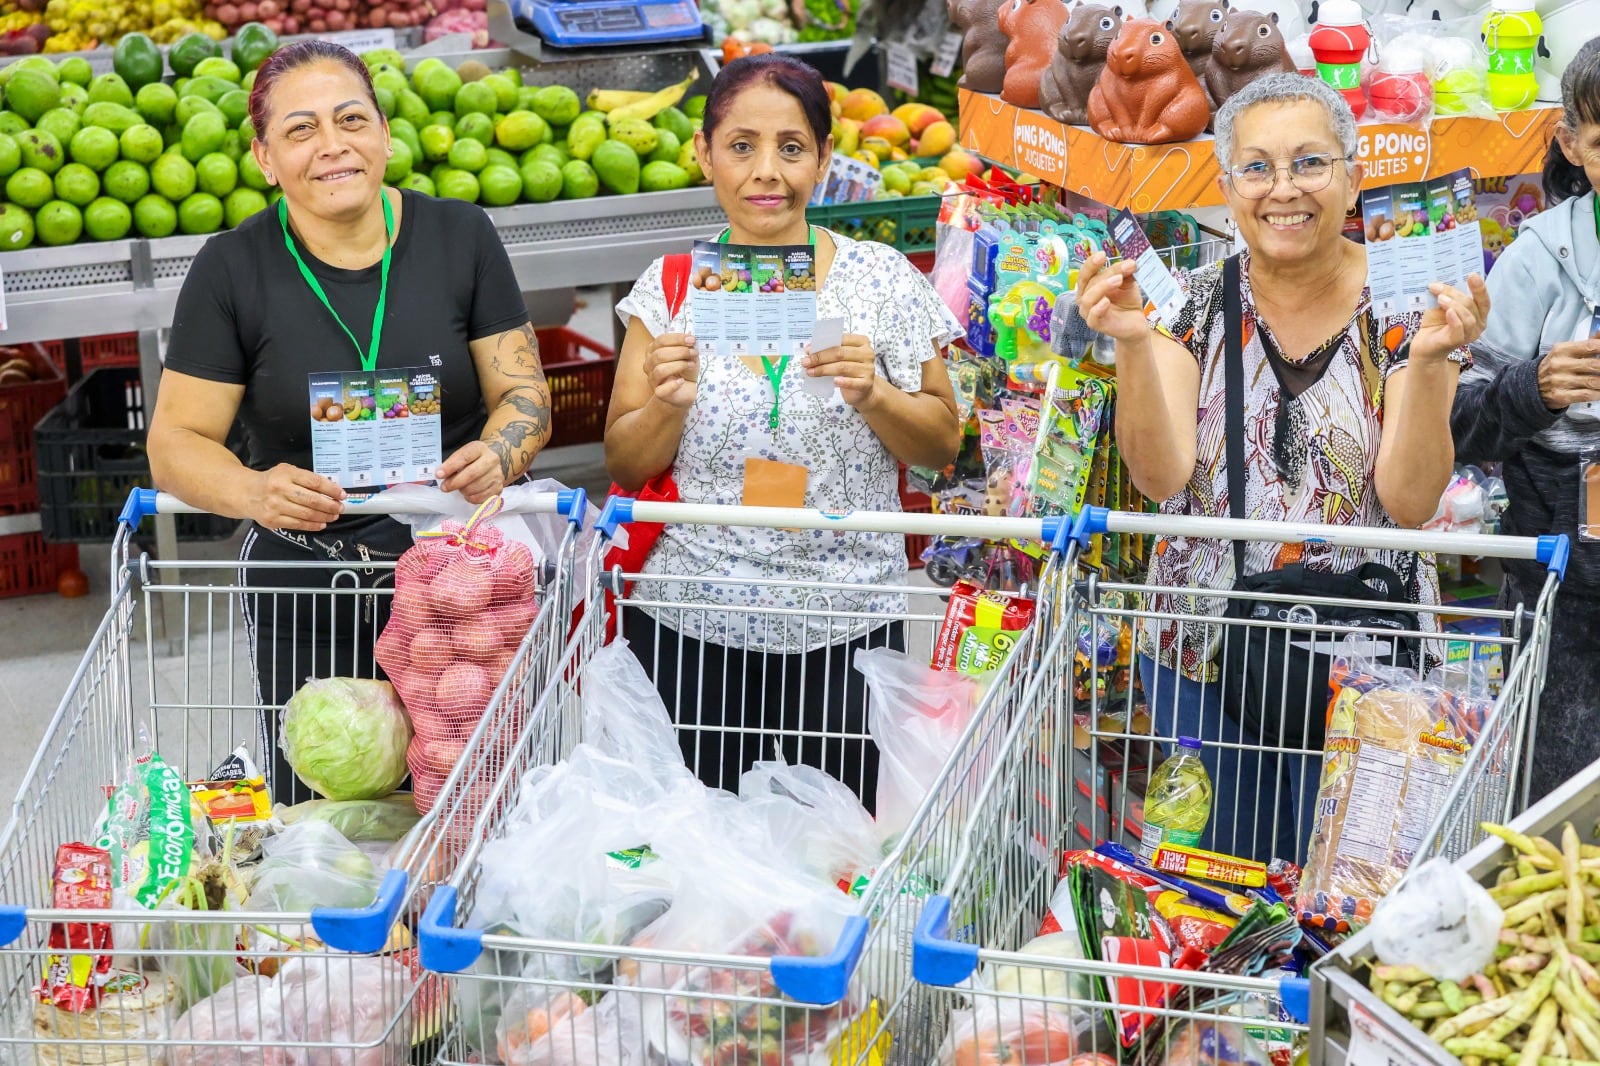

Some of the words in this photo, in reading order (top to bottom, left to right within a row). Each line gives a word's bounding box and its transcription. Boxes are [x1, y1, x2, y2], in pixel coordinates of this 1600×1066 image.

[1016, 125, 1037, 147] PING
[1038, 127, 1065, 157] PONG
[1374, 133, 1427, 156] PONG
[1024, 148, 1056, 173] JUGUETES
[1362, 156, 1408, 178] GUETES
[993, 633, 1015, 654] 6
[1160, 860, 1186, 873] PARTE
[55, 955, 70, 987] noe
